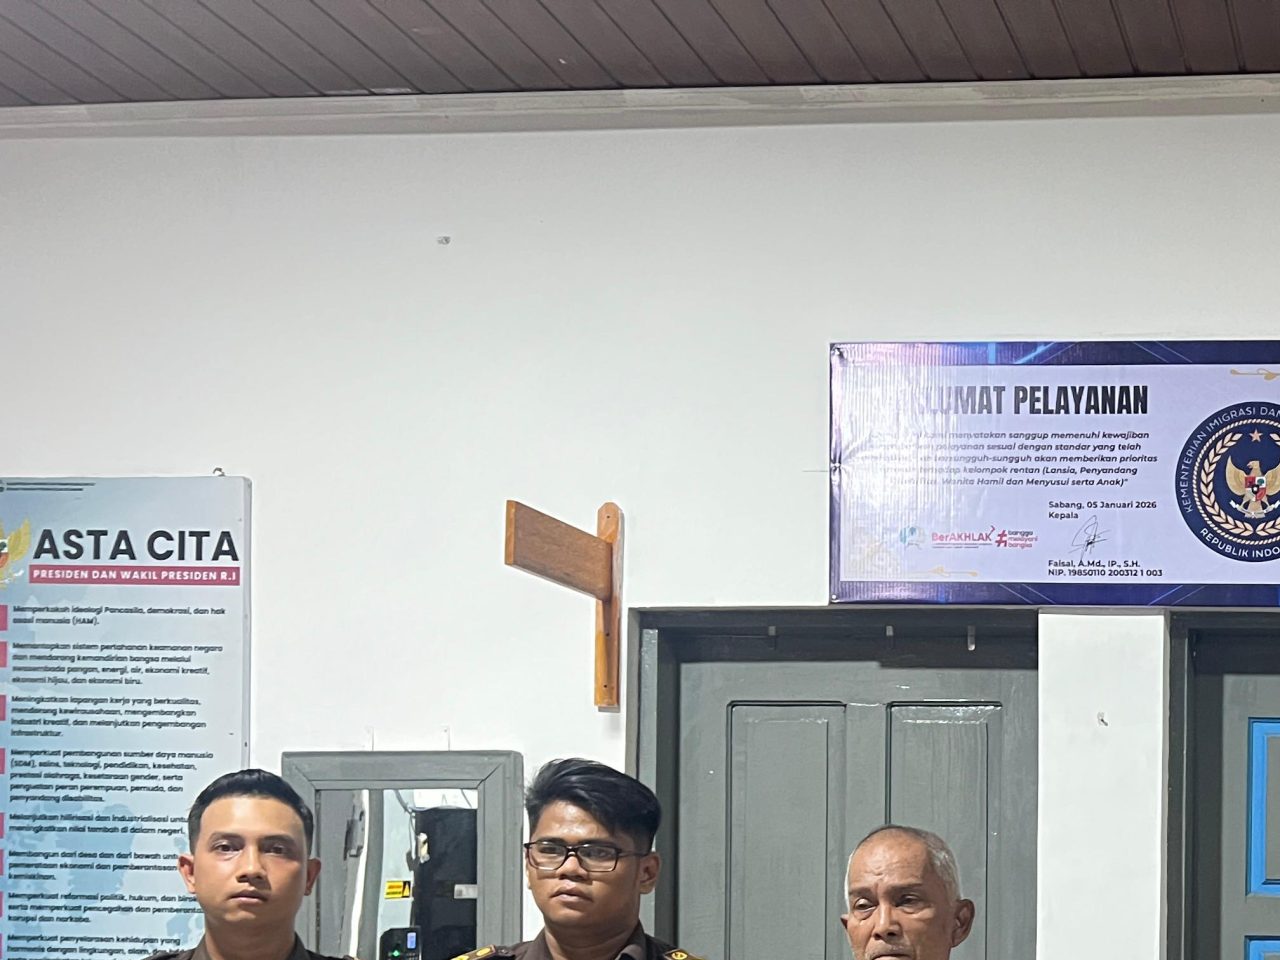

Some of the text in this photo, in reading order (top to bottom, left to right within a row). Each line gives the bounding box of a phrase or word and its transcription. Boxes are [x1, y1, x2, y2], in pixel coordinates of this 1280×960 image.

[920, 385, 1148, 415] LUMAT PELAYANAN
[1008, 431, 1049, 441] sanggup
[1050, 430, 1101, 440] memenuhi
[1102, 430, 1150, 441] kewajiban
[1017, 442, 1053, 454] dengan
[1054, 443, 1091, 452] standar
[1092, 444, 1116, 454] yang
[1117, 442, 1142, 452] telah
[1033, 454, 1158, 466] akan memberikan prioritas
[1178, 431, 1209, 514] KEMENTERIAN
[1206, 406, 1256, 433] IMIGRASI
[963, 466, 1008, 477] kelompok
[1009, 467, 1040, 475] rentan
[1079, 466, 1138, 477] Penyandang
[976, 477, 1005, 486] Hamil
[1005, 477, 1024, 486] dan
[1071, 478, 1095, 487] serta
[1048, 500, 1157, 511] Sabang, 05 Januari 2026
[1048, 510, 1079, 521] Kepala
[931, 531, 993, 542] BerAKHLAK
[32, 528, 240, 562] ASTA CITA
[1200, 527, 1250, 558] REPUBLIK
[1048, 559, 1077, 569] Faisal,
[1123, 560, 1141, 568] S.H.
[33, 569, 89, 579] PRESIDEN
[91, 570, 117, 580] DAN
[119, 570, 158, 580] WAKIL
[160, 570, 217, 581] PRESIDEN
[1048, 568, 1067, 577] NIP.
[1107, 568, 1139, 577] 200312
[1139, 569, 1145, 577] 1
[1145, 569, 1163, 577] 003
